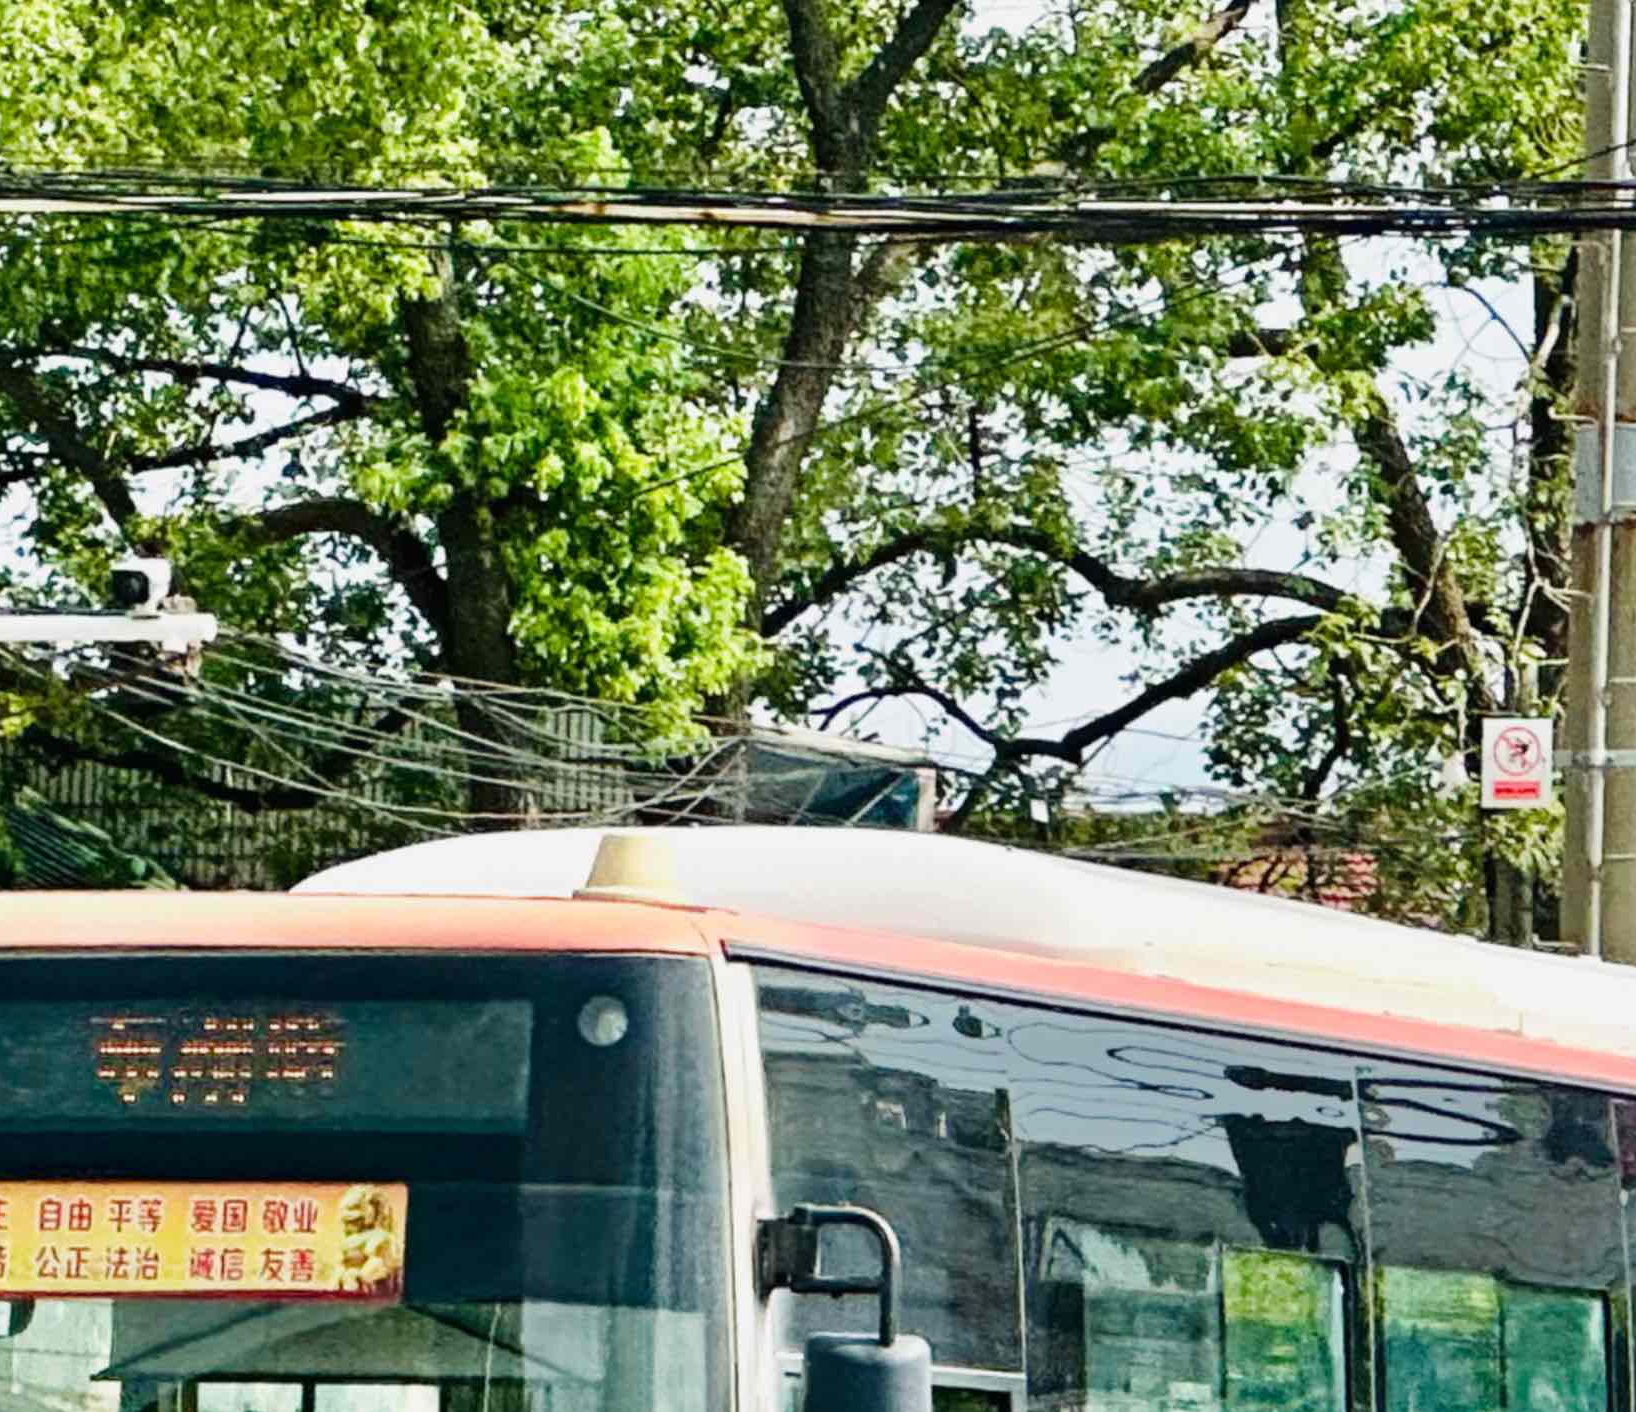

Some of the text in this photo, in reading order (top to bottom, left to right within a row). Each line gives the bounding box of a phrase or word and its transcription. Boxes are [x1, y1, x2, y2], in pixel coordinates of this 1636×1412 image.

[38, 1198, 93, 1233] 自由
[108, 1198, 164, 1233] 平等
[190, 1199, 248, 1234] 爱国
[262, 1199, 318, 1234] 敬业
[35, 1246, 91, 1280] 公正
[105, 1246, 160, 1281] 法治
[189, 1247, 246, 1282] 诚信
[260, 1247, 314, 1282] 友善
